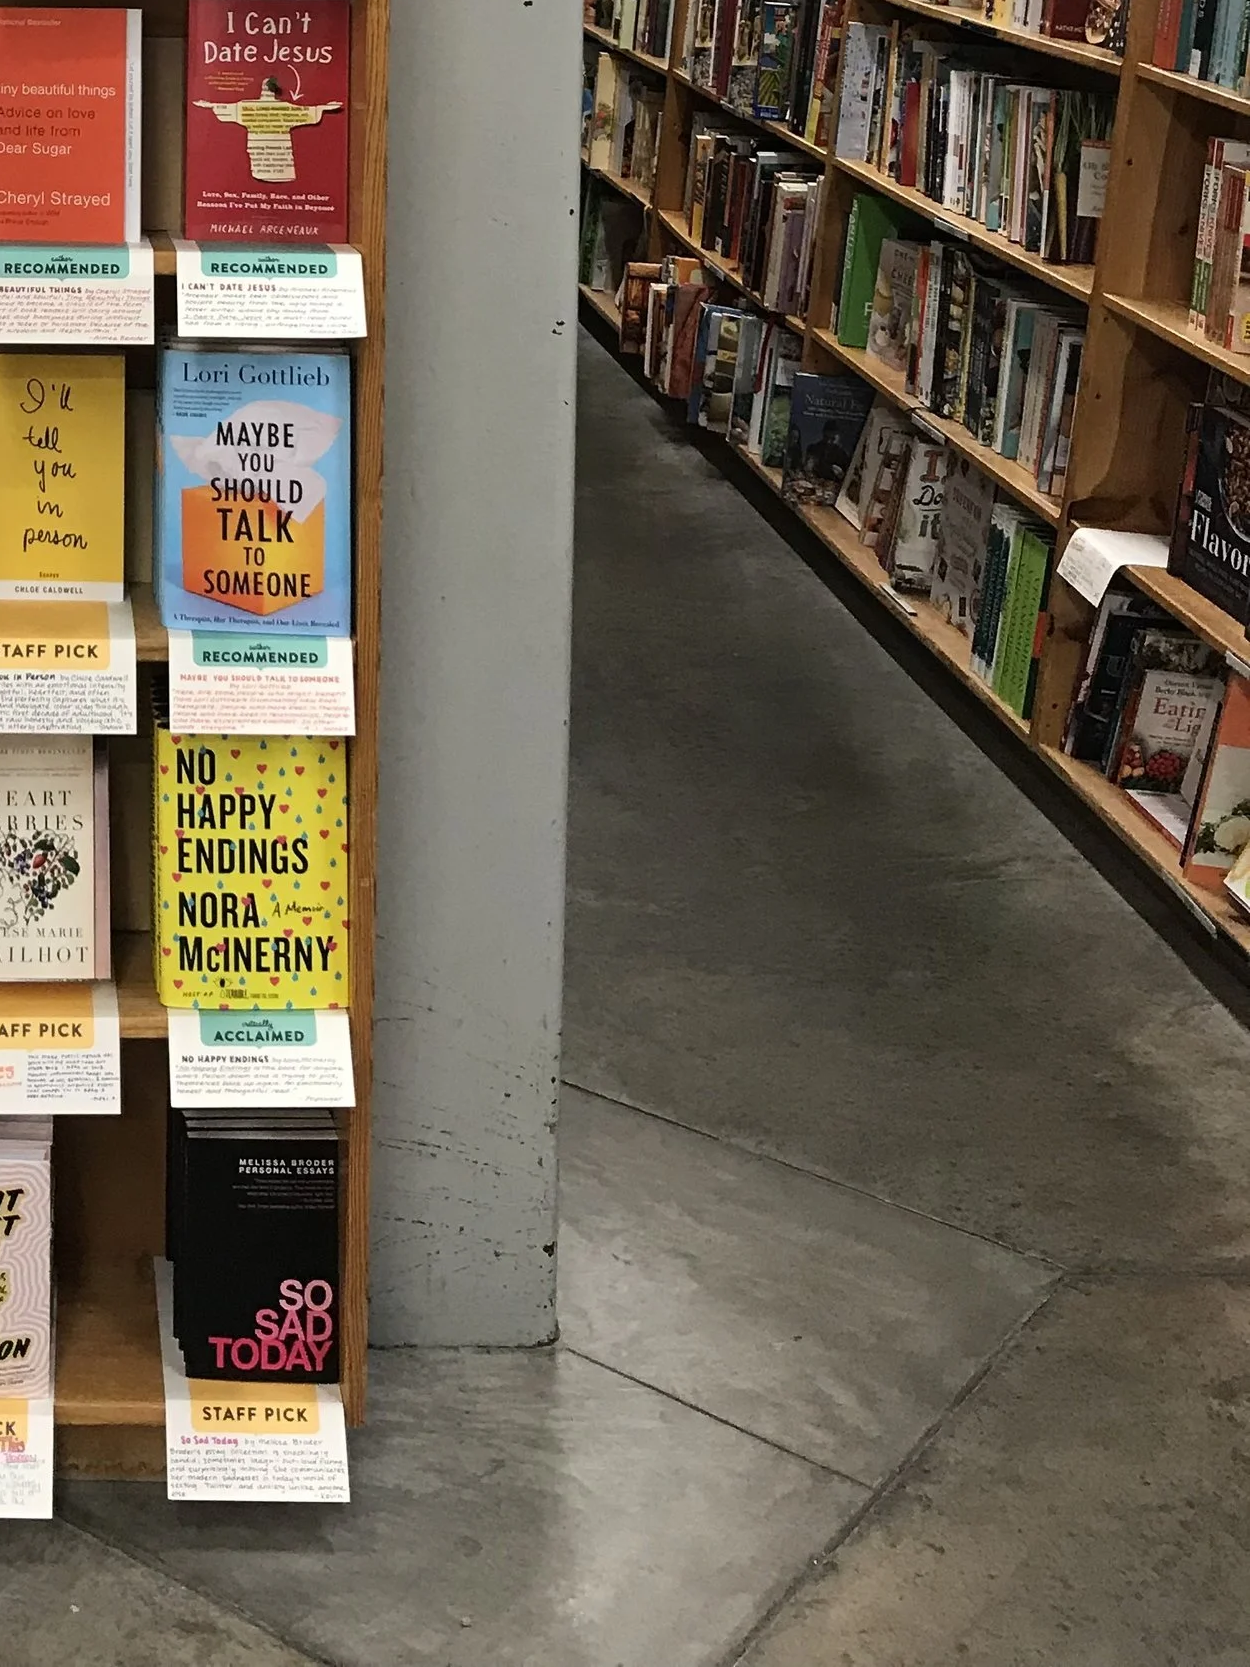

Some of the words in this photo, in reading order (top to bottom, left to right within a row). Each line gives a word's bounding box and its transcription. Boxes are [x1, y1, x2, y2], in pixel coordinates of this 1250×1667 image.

[227, 11, 234, 33] I
[245, 12, 311, 34] Can't
[204, 41, 257, 63] Date
[263, 40, 332, 63] Jesus
[22, 84, 75, 96] beautiful
[78, 84, 116, 98] things
[50, 191, 111, 207] Strayed
[211, 262, 328, 274] RECOMMENDED
[183, 363, 230, 384] Lori
[238, 363, 330, 386] Gottlieb
[20, 379, 73, 413] I'll
[22, 426, 62, 453] tell
[216, 422, 294, 448] MAYBE
[211, 478, 303, 503] SHOULD
[217, 508, 294, 542] TALK
[22, 529, 87, 552] person
[204, 570, 312, 597] SOMEONE
[178, 794, 275, 829] HAPPY
[178, 838, 308, 874] ENDINGS
[179, 935, 334, 973] McINERNY
[239, 1159, 286, 1167] MELISSA
[292, 1159, 334, 1167] BRODER
[239, 1167, 292, 1175] PERSONAL
[297, 1167, 334, 1175] ESSAYS
[255, 1309, 333, 1342] SAD
[209, 1338, 333, 1371] TODAY
[203, 1407, 256, 1421] STAFF
[268, 1407, 307, 1422] PICK
